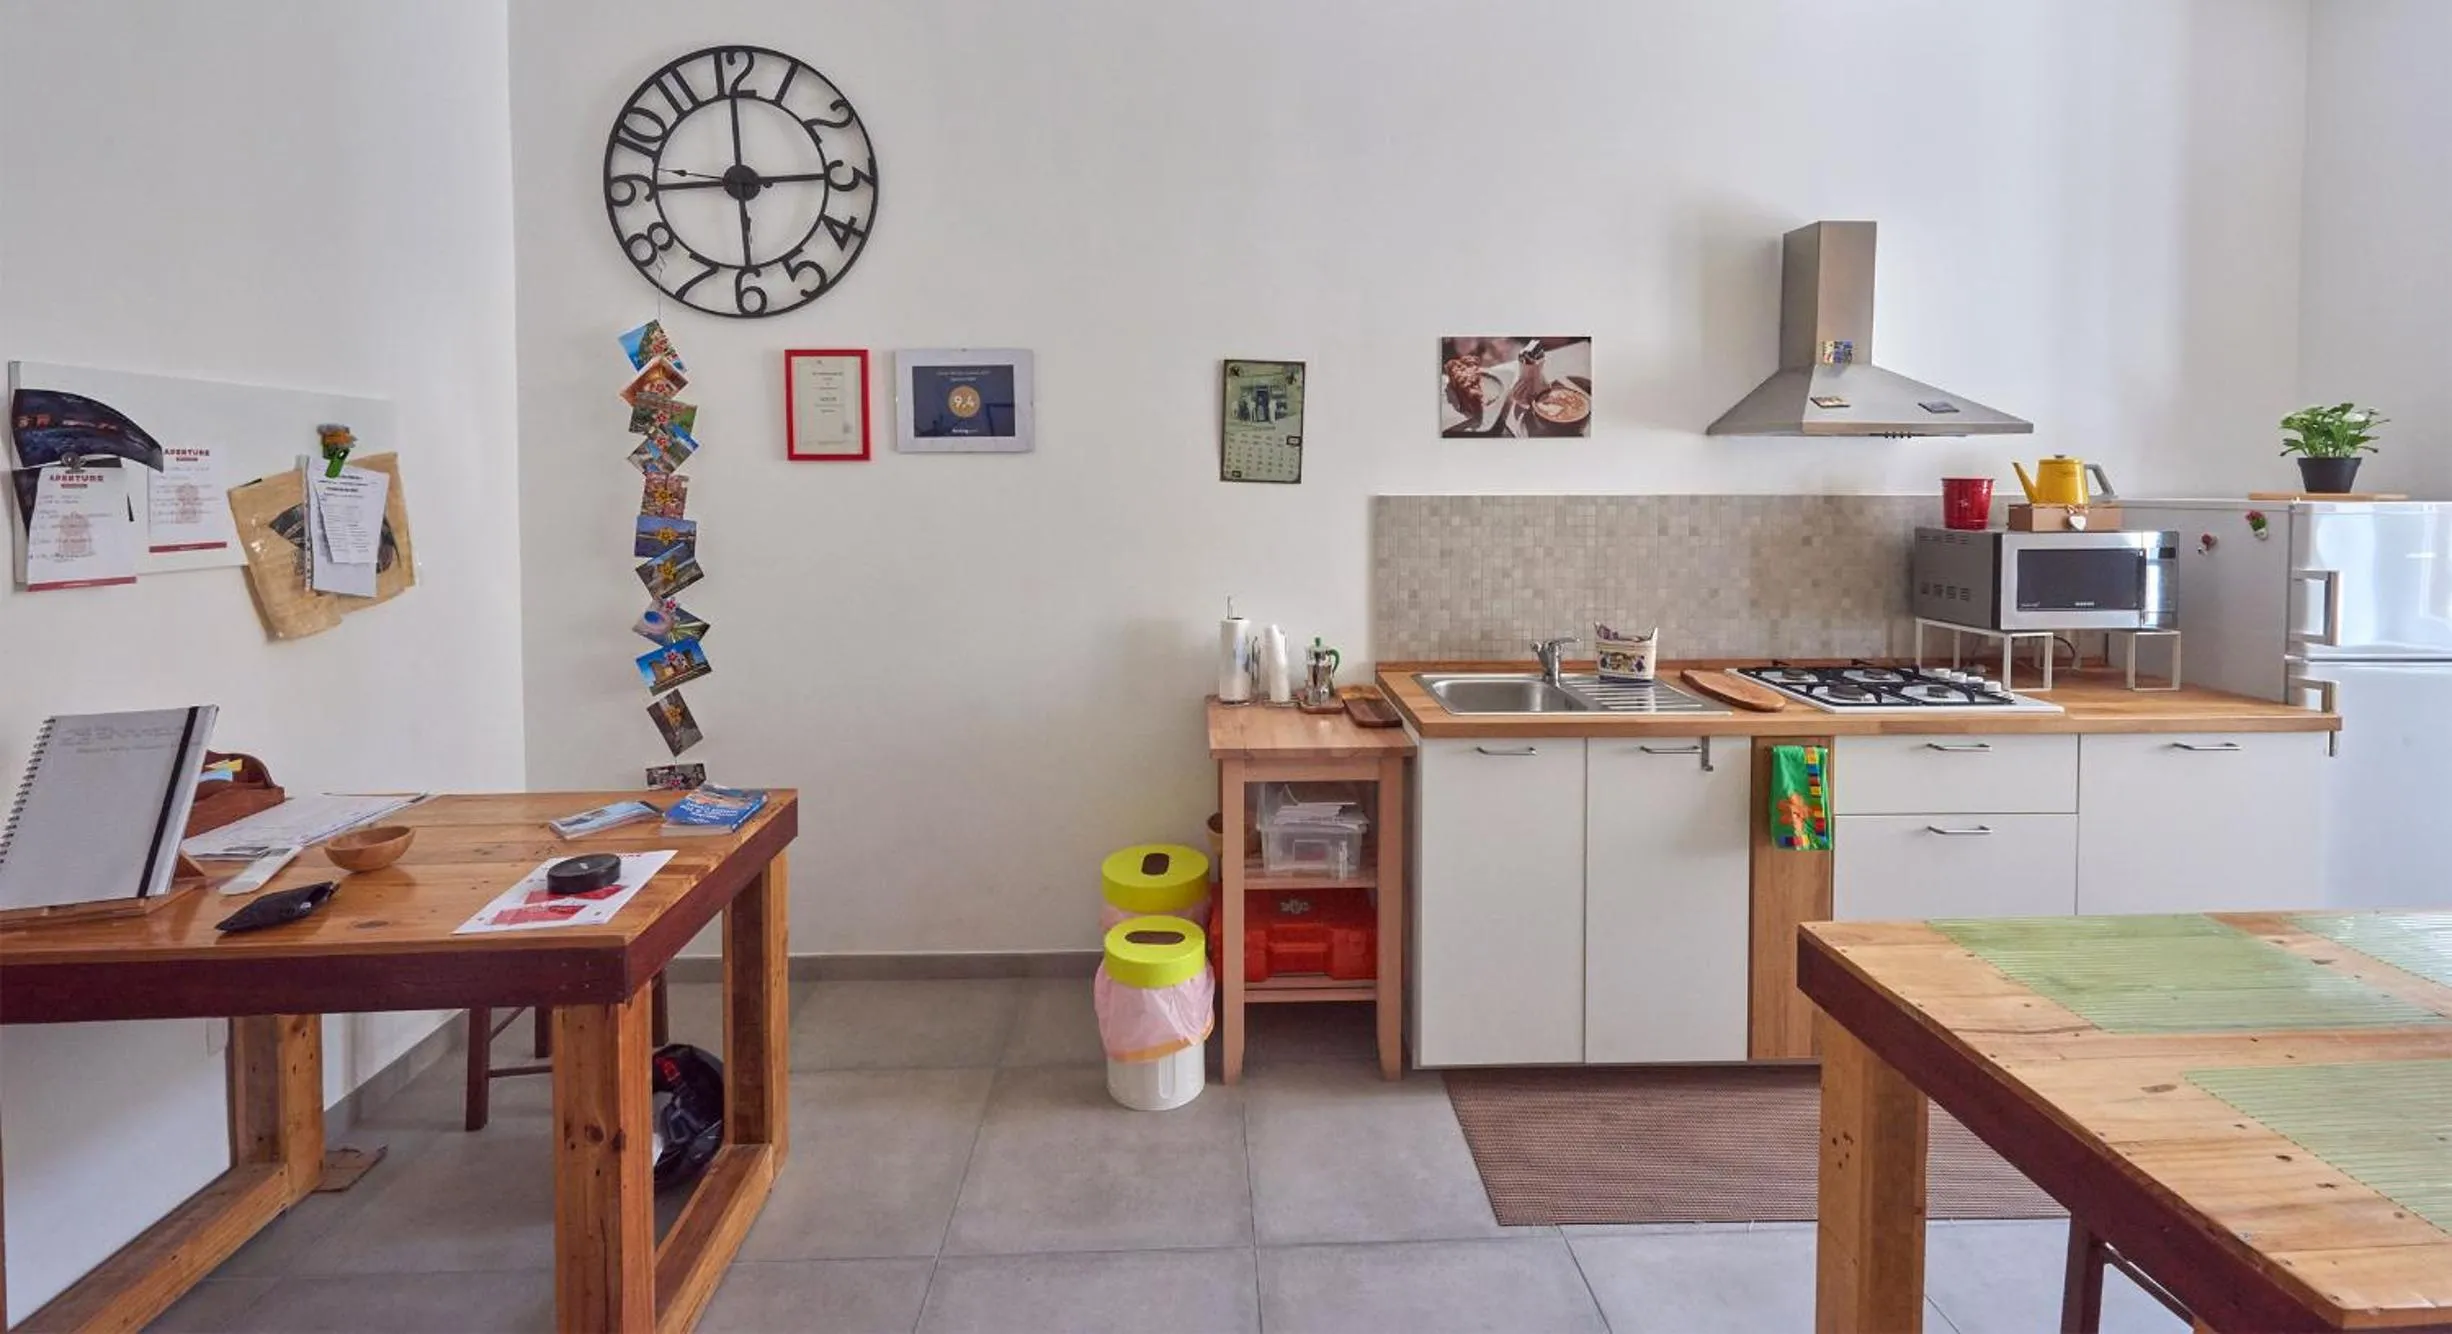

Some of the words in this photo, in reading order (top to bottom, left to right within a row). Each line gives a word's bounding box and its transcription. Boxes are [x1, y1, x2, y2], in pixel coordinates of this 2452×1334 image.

[654, 66, 701, 118] 11
[714, 48, 757, 98] 12
[775, 61, 800, 105] 1
[614, 107, 668, 162] 10
[801, 98, 855, 145] 2
[609, 174, 656, 207] 9
[826, 157, 876, 192] 3
[625, 222, 674, 267] 8
[821, 213, 866, 251] 4
[675, 252, 720, 301] 7
[735, 266, 768, 316] 6
[781, 248, 828, 299] 5
[954, 395, 975, 408] 9.4
